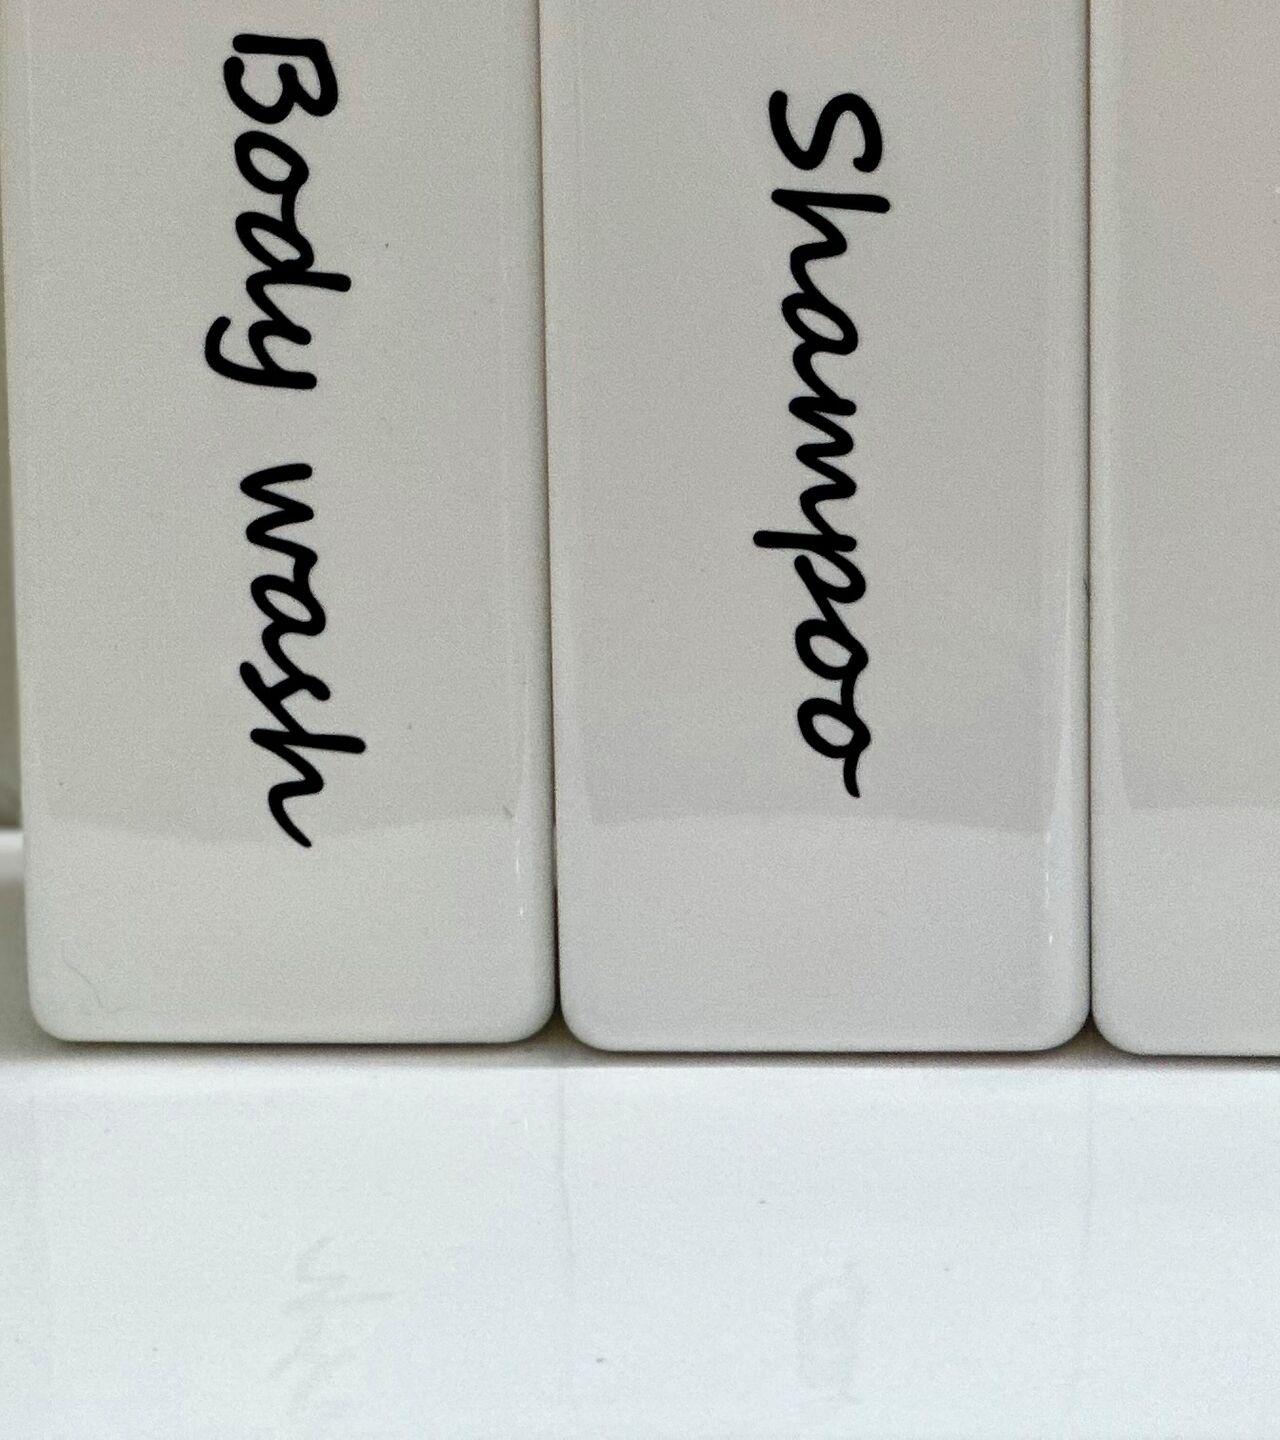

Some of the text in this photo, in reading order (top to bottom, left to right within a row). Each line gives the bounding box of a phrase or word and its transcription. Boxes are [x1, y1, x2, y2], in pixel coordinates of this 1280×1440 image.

[204, 33, 367, 849] Body wash
[752, 89, 892, 799] Shampoo
